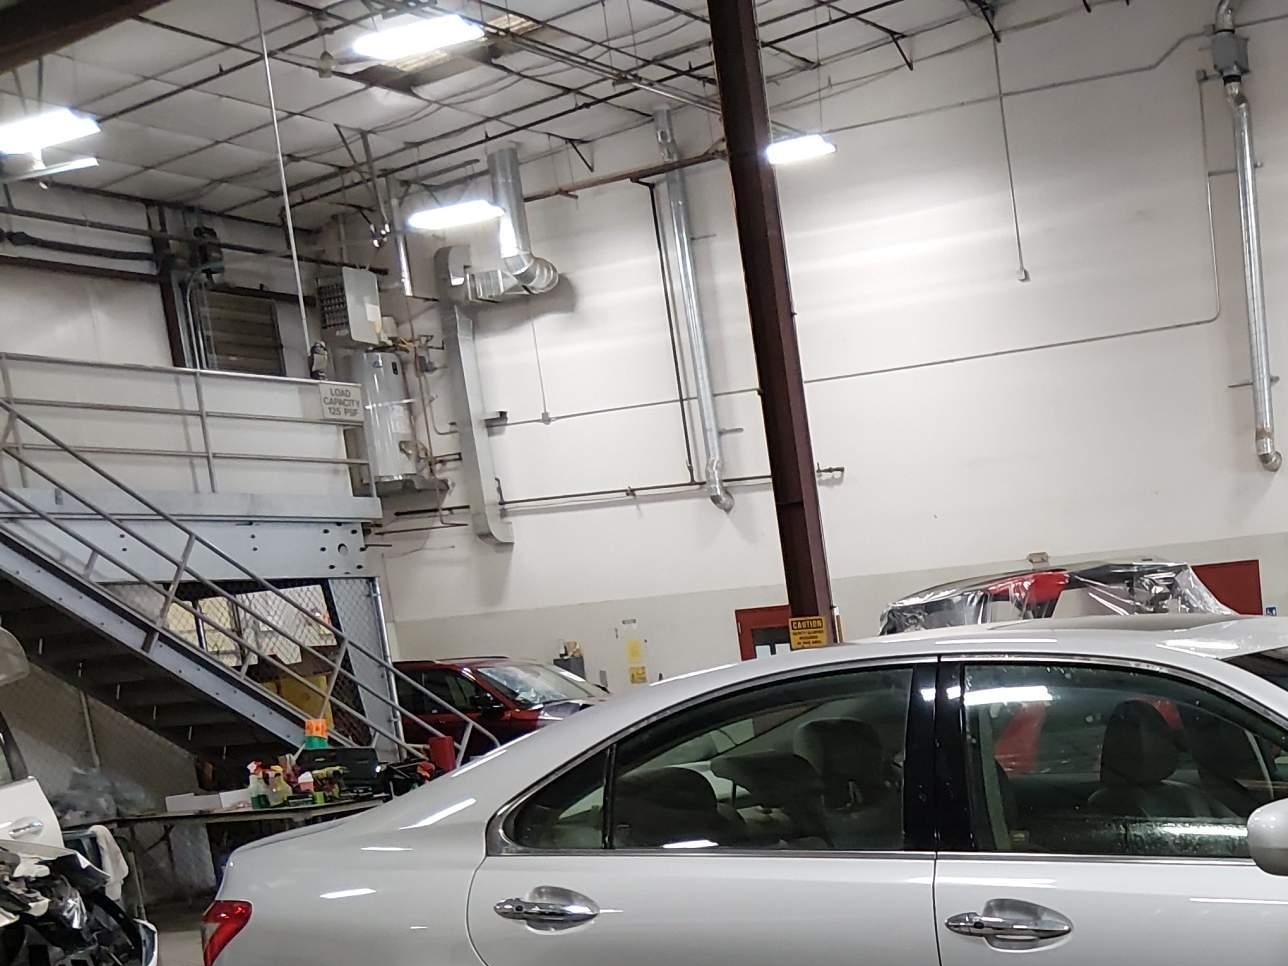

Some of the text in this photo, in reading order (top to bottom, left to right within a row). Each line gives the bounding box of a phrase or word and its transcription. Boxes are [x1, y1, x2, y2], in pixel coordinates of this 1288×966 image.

[330, 388, 351, 397] LOAD
[323, 397, 360, 408] CAPACITY
[328, 407, 341, 416] 125
[792, 620, 822, 630] CAUTION
